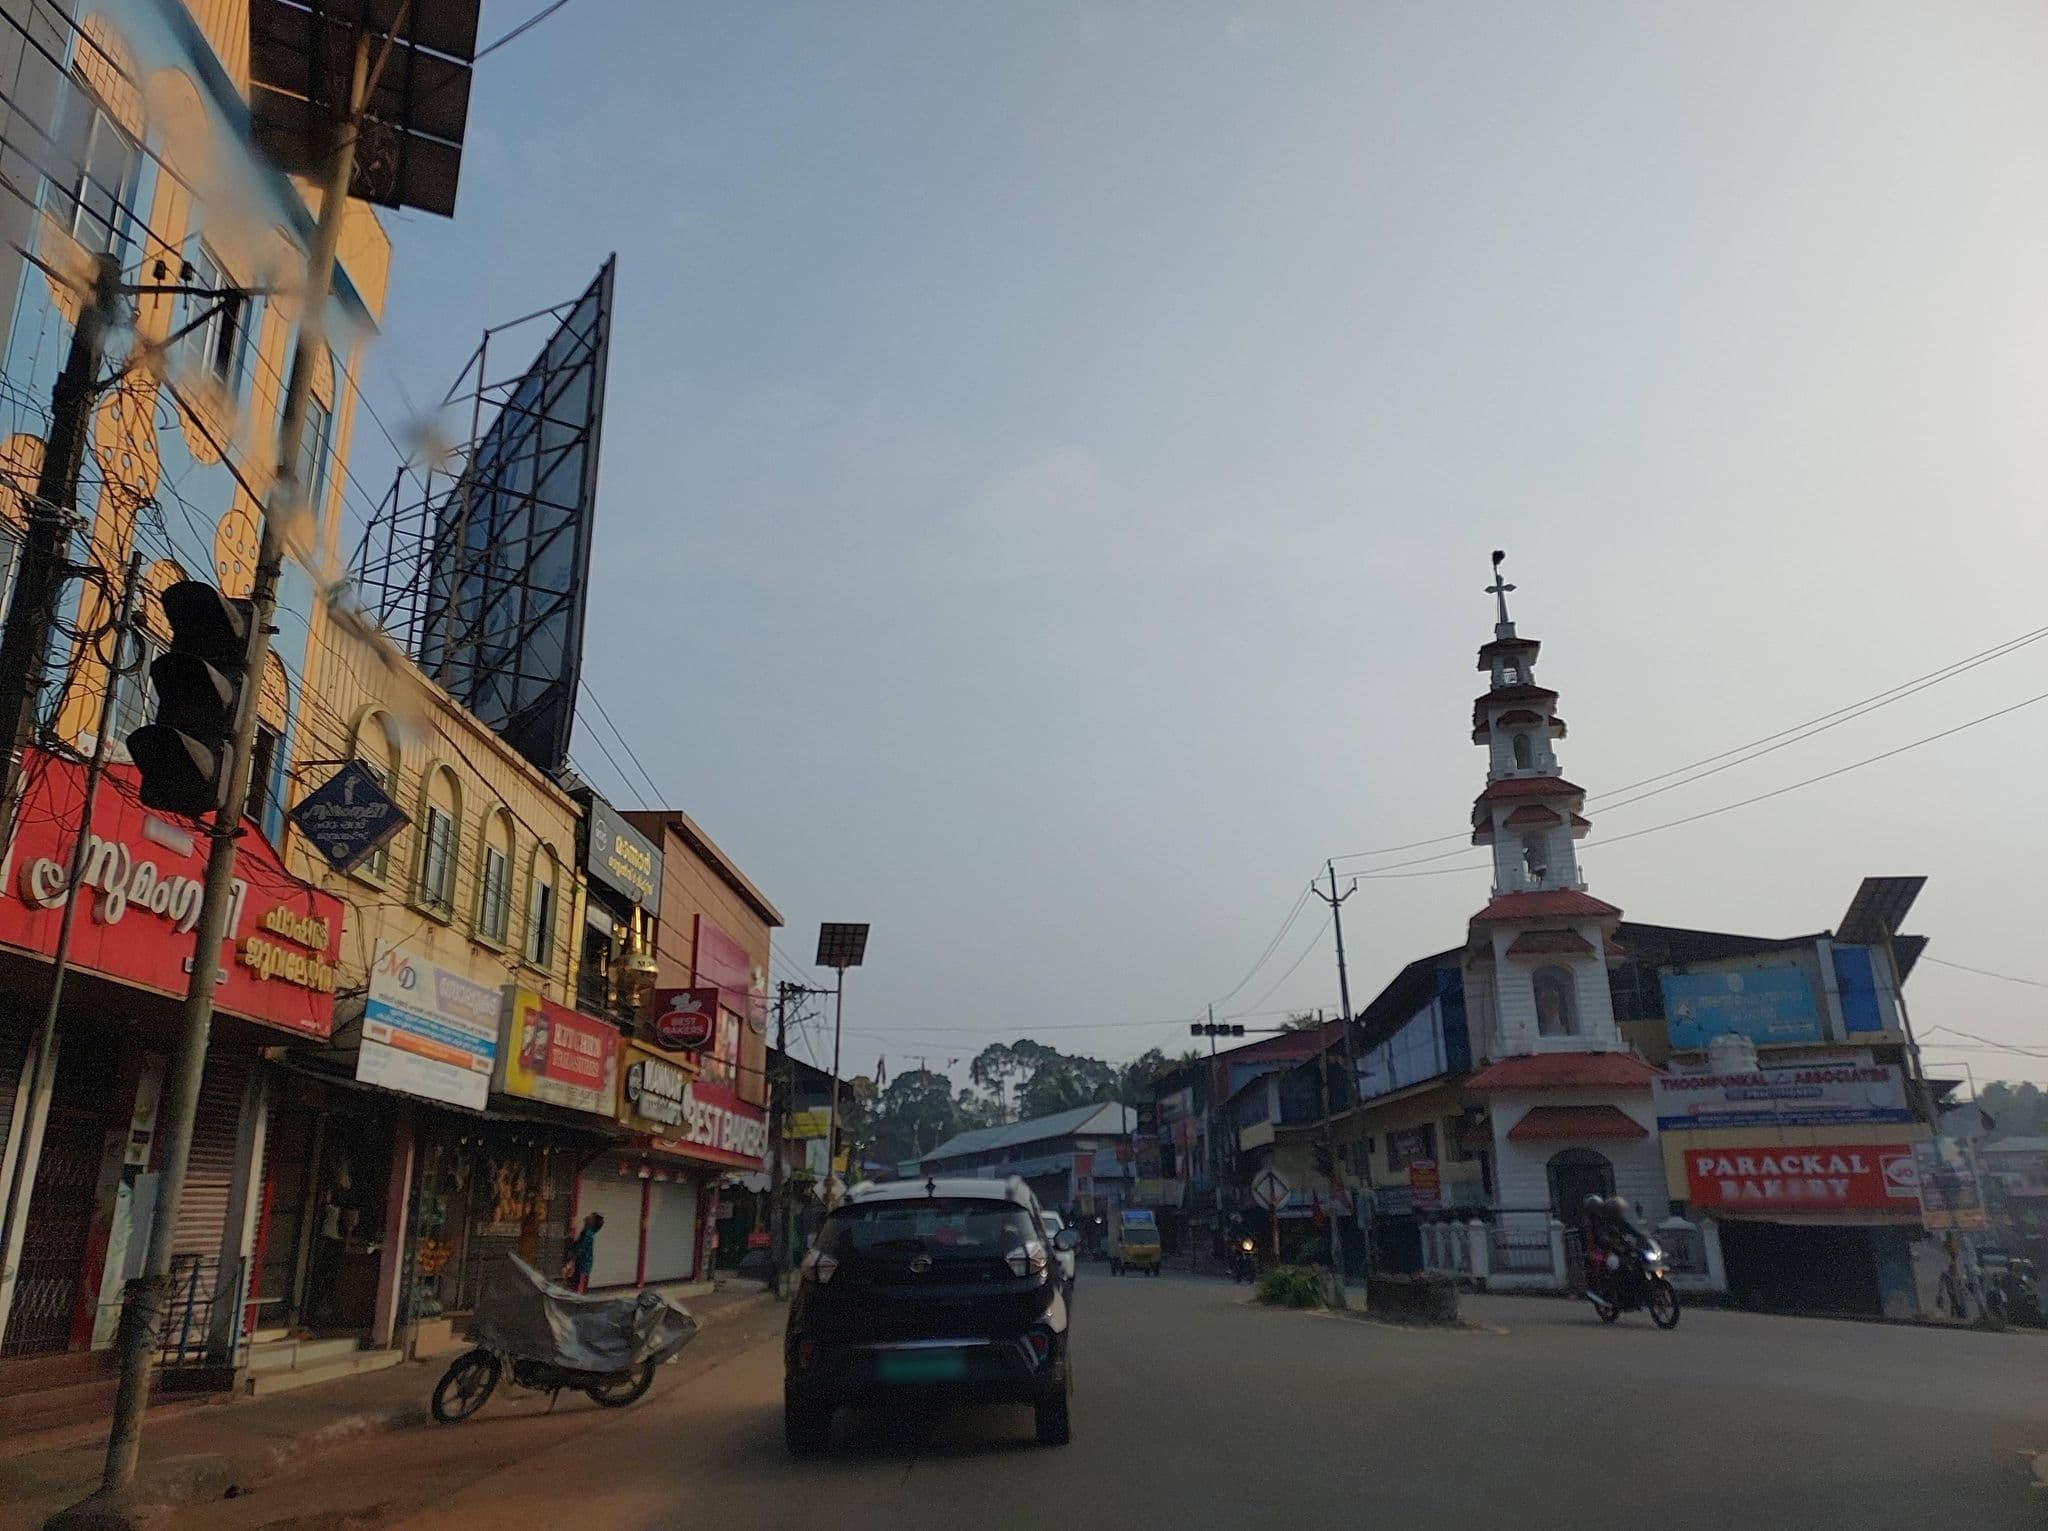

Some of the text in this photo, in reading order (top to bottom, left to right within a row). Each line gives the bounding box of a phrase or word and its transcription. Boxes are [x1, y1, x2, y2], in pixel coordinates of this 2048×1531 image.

[30, 834, 248, 940] സുമംഗി
[1696, 1154, 1871, 1177] PARACKAL
[1720, 1178, 1850, 1200] BAKERY
